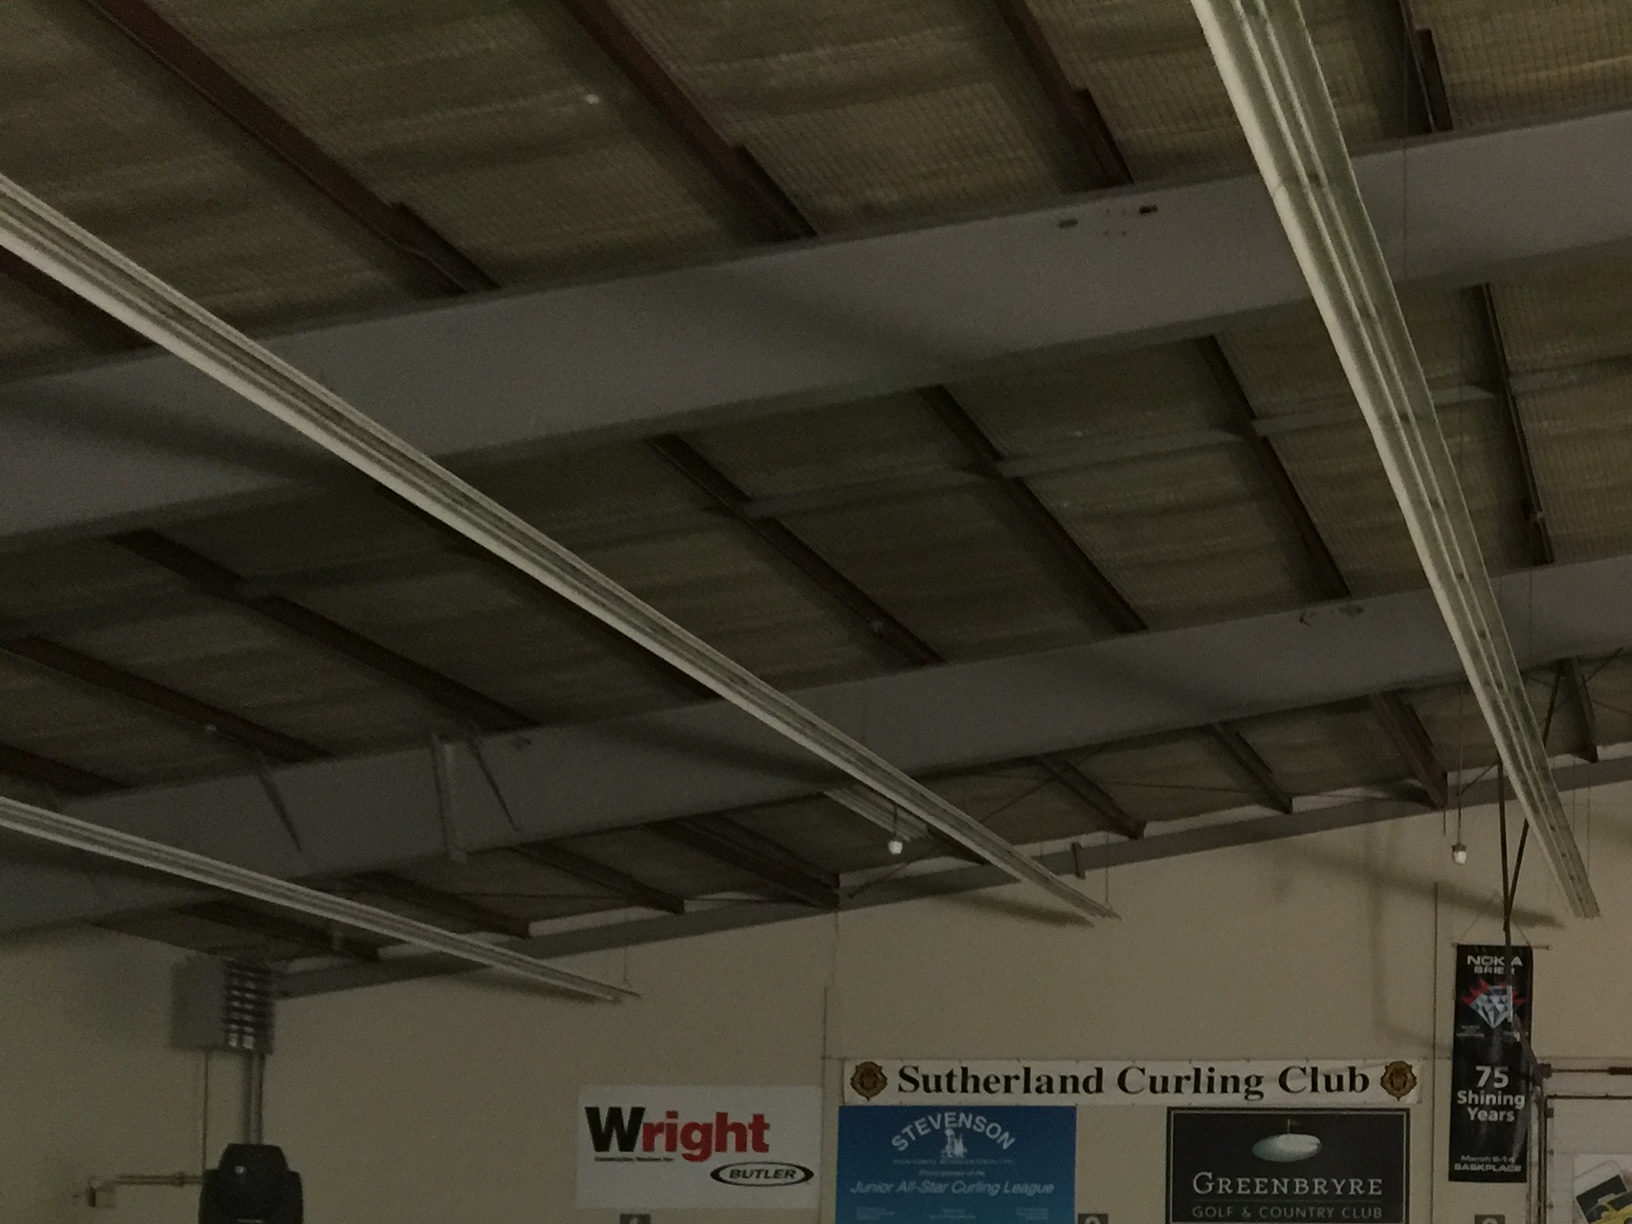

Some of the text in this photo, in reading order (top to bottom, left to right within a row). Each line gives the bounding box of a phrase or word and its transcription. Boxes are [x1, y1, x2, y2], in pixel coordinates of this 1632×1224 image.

[1467, 955, 1523, 966] NOKA
[898, 1064, 1372, 1100] Sutherland Curling Club
[1476, 1065, 1509, 1088] 75
[1457, 1090, 1526, 1109] Shining
[1467, 1107, 1515, 1122] Years
[585, 1106, 770, 1162] Wright
[891, 1111, 1016, 1151] STEVENSON
[729, 1169, 796, 1180] BUTLER
[1192, 1171, 1383, 1196] GREENBRYRE
[850, 1180, 1055, 1197] Junior All-Star Curling League
[1192, 1206, 1383, 1220] GOLF & COUNTRY CLUB
